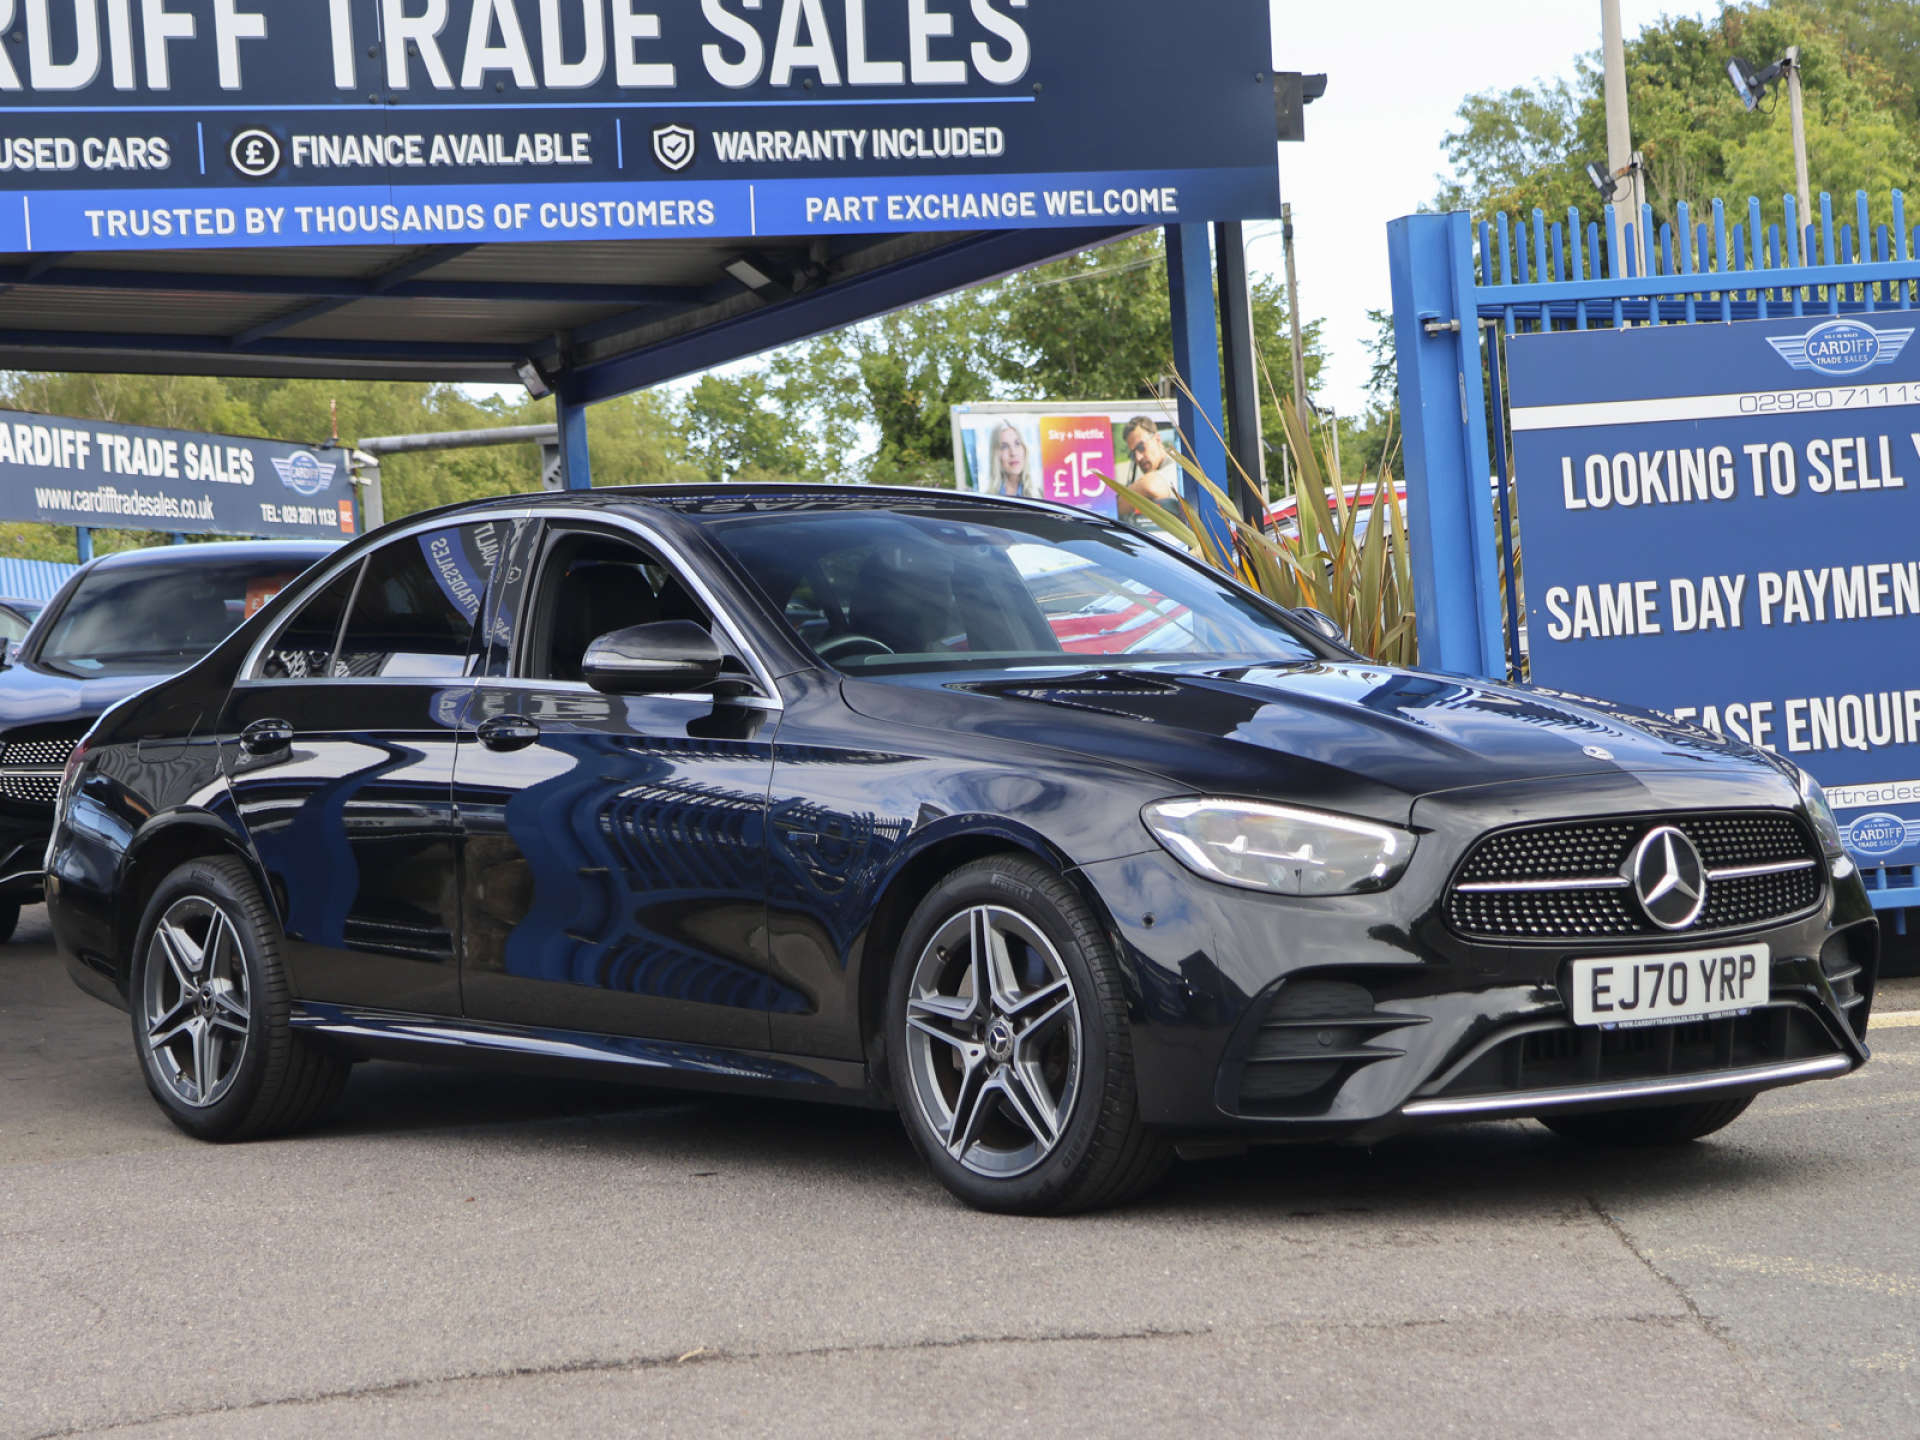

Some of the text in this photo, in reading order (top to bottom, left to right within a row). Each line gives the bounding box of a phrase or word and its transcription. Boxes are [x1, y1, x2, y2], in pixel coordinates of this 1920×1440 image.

[329, 0, 677, 90] TRADE
[701, 0, 1031, 88] SALES
[0, 137, 171, 171] USED CARS
[291, 132, 592, 167] FINANCE AVAILABLE
[712, 126, 1005, 161] WARRANTY INCLUDED
[85, 199, 716, 238] TRUSTED BY THOUSANDS OF CUSTOMERS
[805, 187, 1178, 223] PART EXCHANGE WELCOME
[1808, 338, 1874, 357] CARDIFF
[1816, 354, 1869, 365] TRADE SALES
[1739, 389, 1833, 412] 02920
[1047, 429, 1066, 443] Sky
[1073, 428, 1105, 440] Netflix
[96, 432, 180, 480] TRADE
[184, 442, 256, 486] SALES
[1052, 451, 1106, 498] £15
[1561, 446, 1736, 510] LOOKING
[1743, 441, 1796, 498] TO
[1806, 434, 1905, 494] SELL
[35, 486, 215, 521] www.cardifftradesales.co.uk
[260, 503, 282, 523] TEL:
[1545, 561, 1920, 642] SAME DAY PAYMEN
[1852, 826, 1903, 842] CARDIFF
[1591, 953, 1757, 1014] EJ70 YRP
